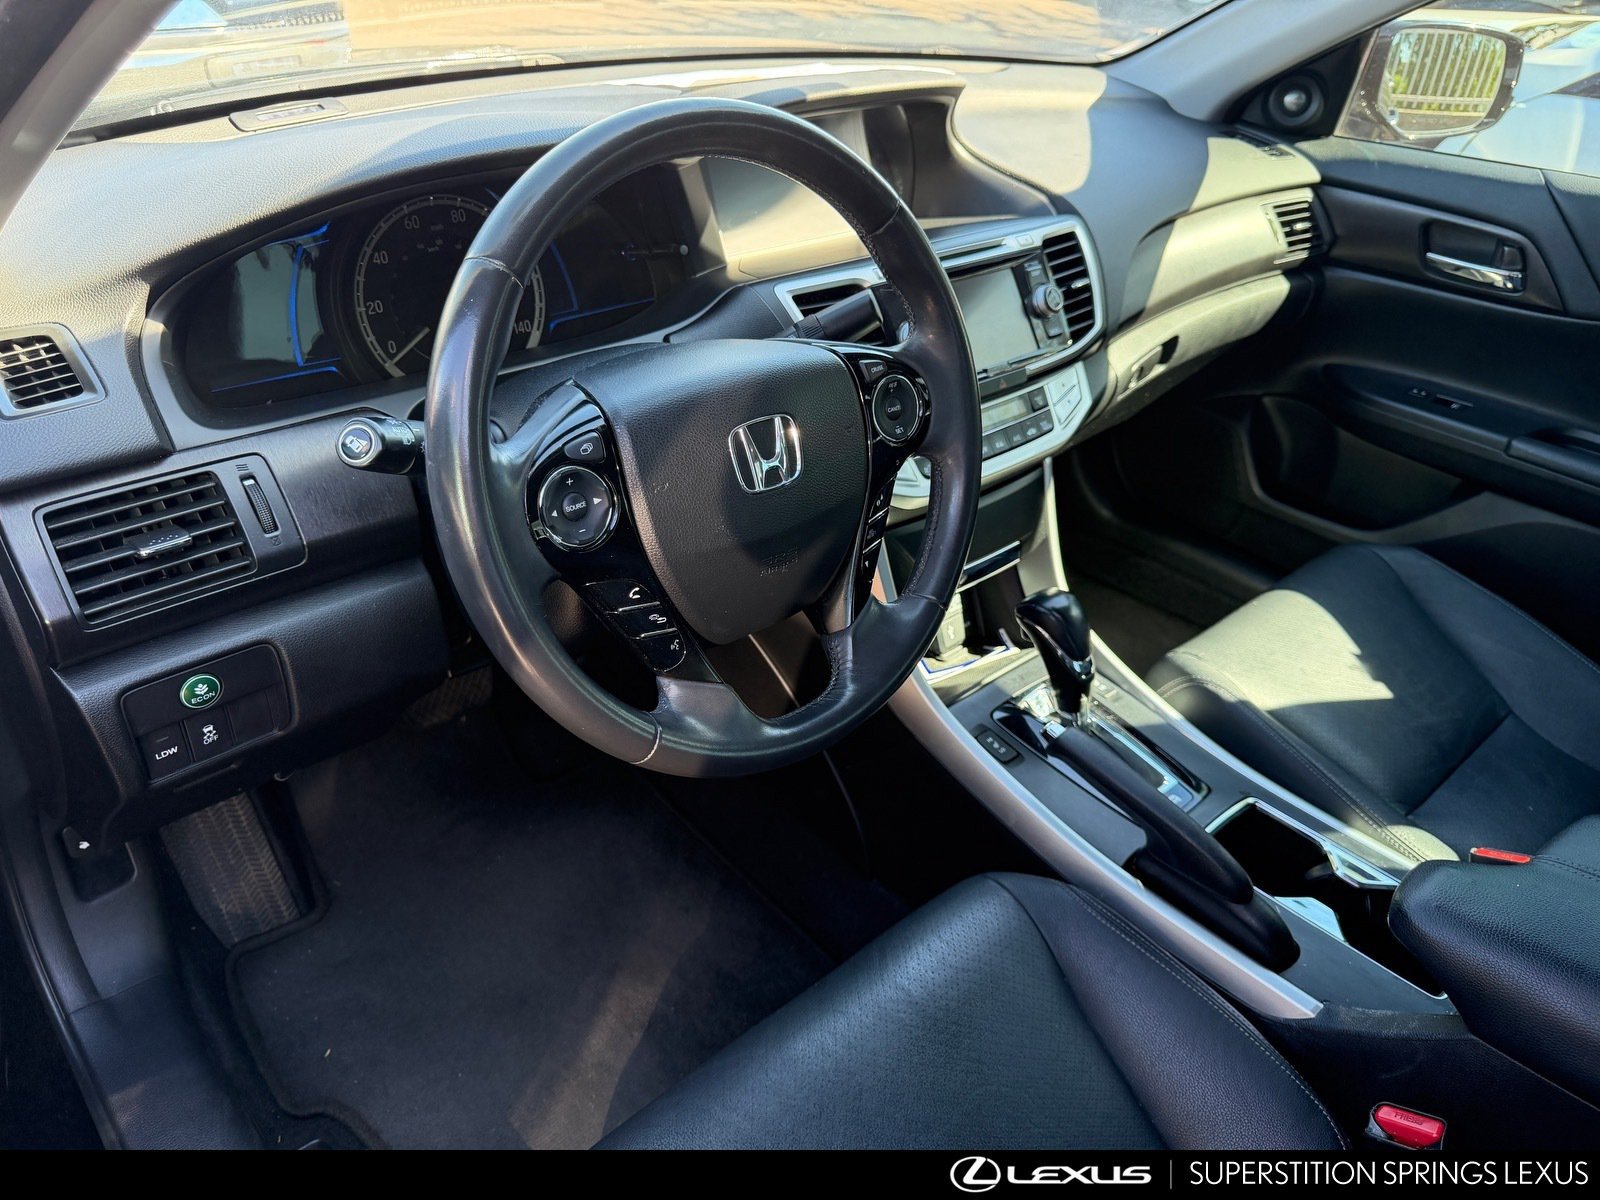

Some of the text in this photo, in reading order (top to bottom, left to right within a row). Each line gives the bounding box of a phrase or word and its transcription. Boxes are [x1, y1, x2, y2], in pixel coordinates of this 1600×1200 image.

[404, 215, 420, 230] 60
[451, 208, 466, 223] 80
[372, 250, 389, 265] 40
[366, 300, 384, 315] 20
[514, 319, 531, 334] 140
[388, 340, 397, 354] 0
[565, 500, 587, 513] SOURCE
[191, 690, 216, 704] ECON
[203, 734, 219, 745] OFF
[155, 746, 178, 761] LDW
